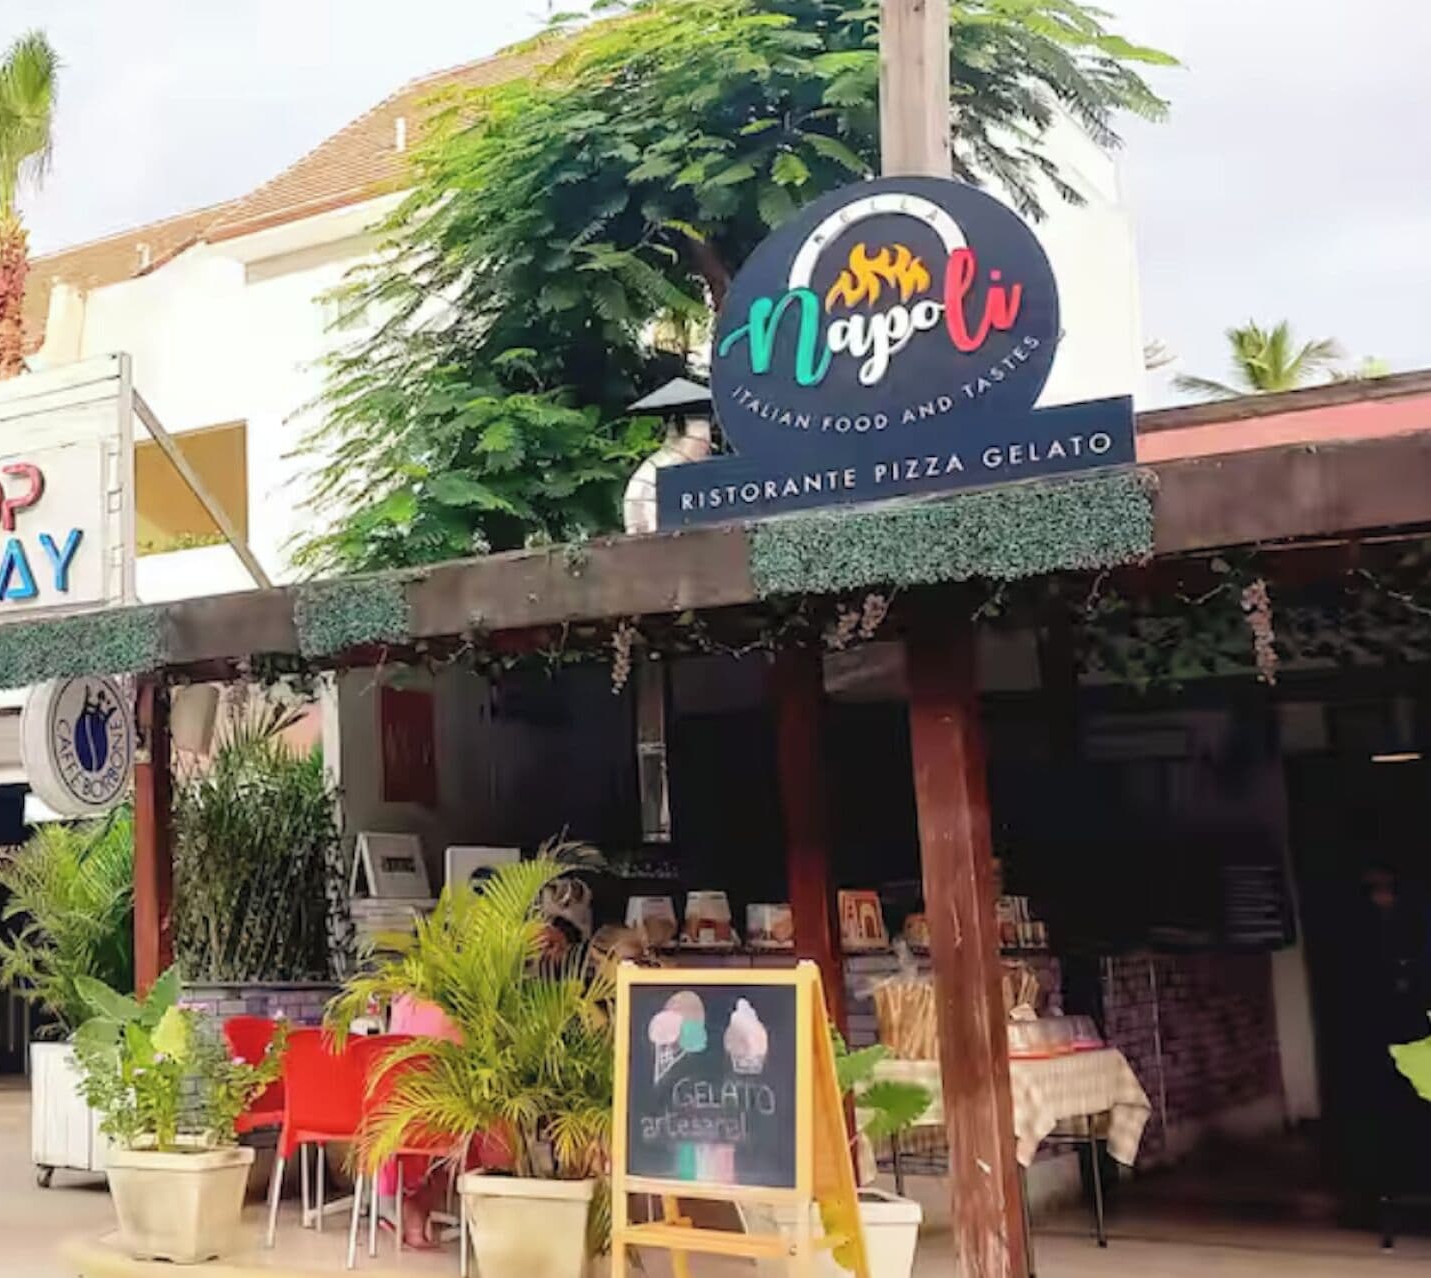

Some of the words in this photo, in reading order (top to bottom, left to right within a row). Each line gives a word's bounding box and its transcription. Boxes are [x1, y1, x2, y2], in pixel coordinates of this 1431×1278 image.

[731, 385, 811, 430] ITALIAN
[821, 413, 888, 434] FOOD
[902, 395, 952, 425] AND
[962, 333, 1041, 400] TASTES
[680, 466, 857, 511] RISTORANTE
[875, 454, 965, 485] PIZZA
[982, 431, 1112, 468] GELATO
[82, 719, 124, 798] BORBONE
[672, 1077, 776, 1115] GELATO
